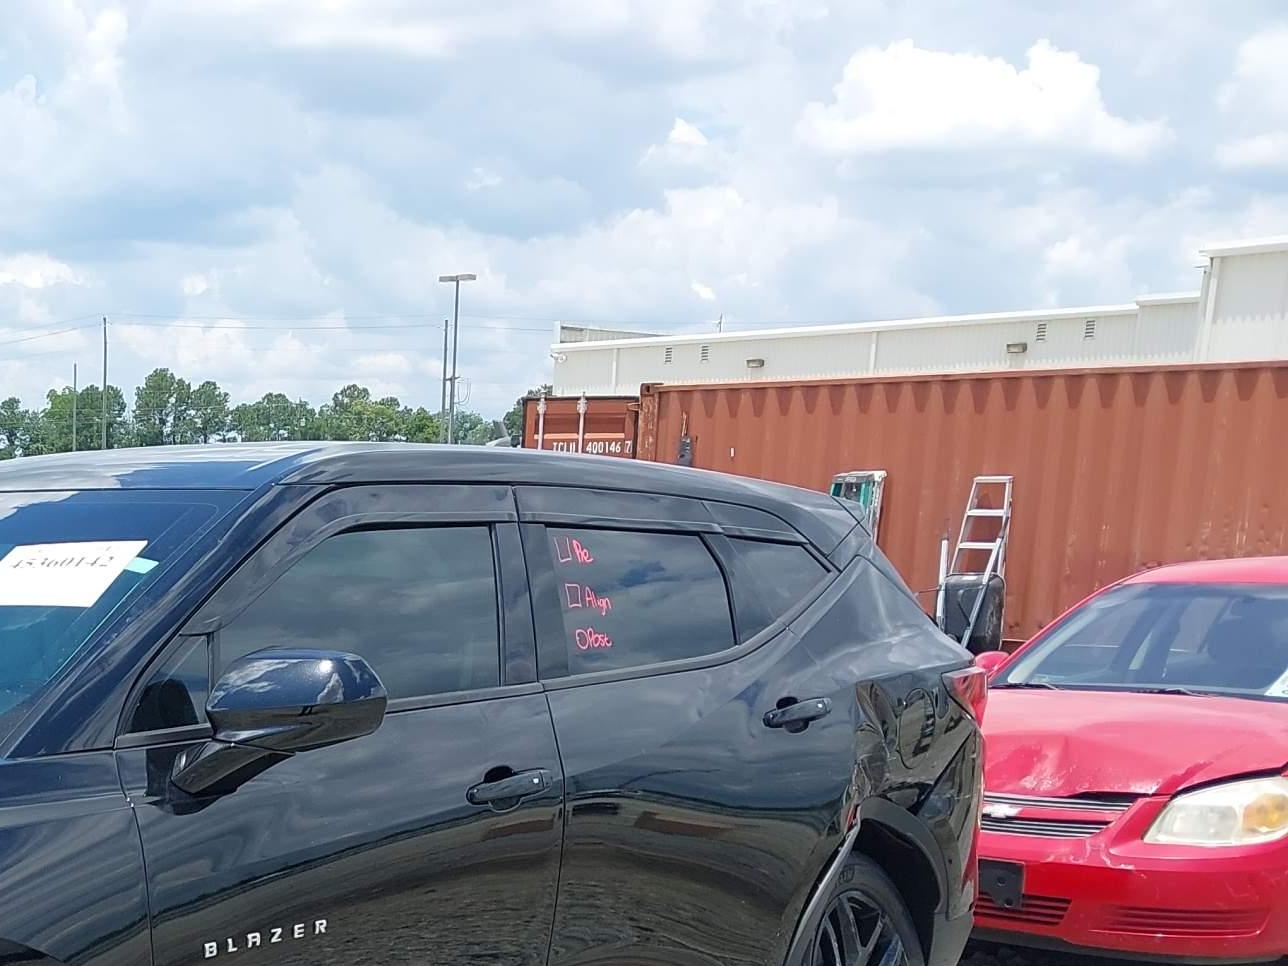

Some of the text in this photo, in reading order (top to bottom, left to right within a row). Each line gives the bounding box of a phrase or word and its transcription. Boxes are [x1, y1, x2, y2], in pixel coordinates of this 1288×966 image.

[586, 441, 621, 454] 400146
[585, 586, 612, 616] Align
[204, 919, 328, 958] BLAZER
